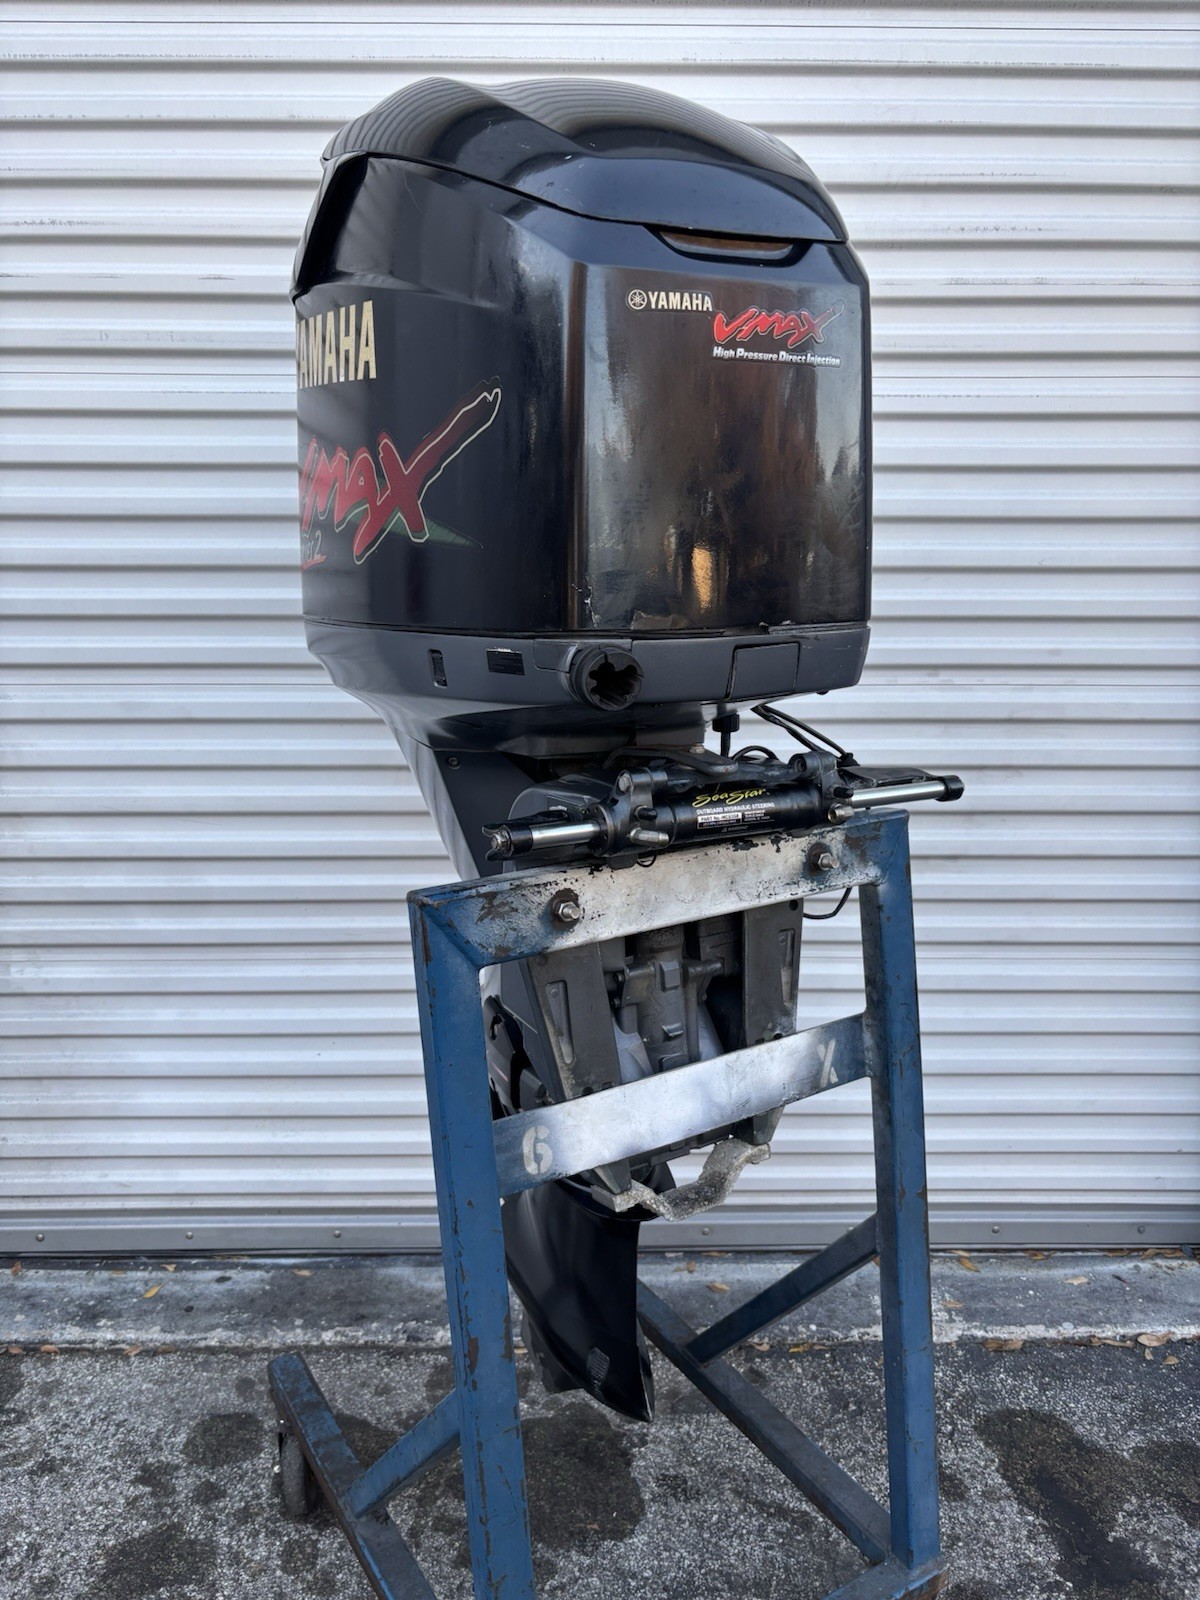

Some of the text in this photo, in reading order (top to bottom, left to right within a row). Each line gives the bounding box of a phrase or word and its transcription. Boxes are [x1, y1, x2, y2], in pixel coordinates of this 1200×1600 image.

[648, 291, 713, 312] YAMAHA
[296, 300, 377, 389] AMAHA
[713, 346, 841, 367] High Pressure Direct Injection
[692, 788, 767, 808] SeaStar
[696, 807, 723, 815] OUTBOARD
[724, 804, 751, 813] HYDRAULIC
[522, 1124, 554, 1176] 6
